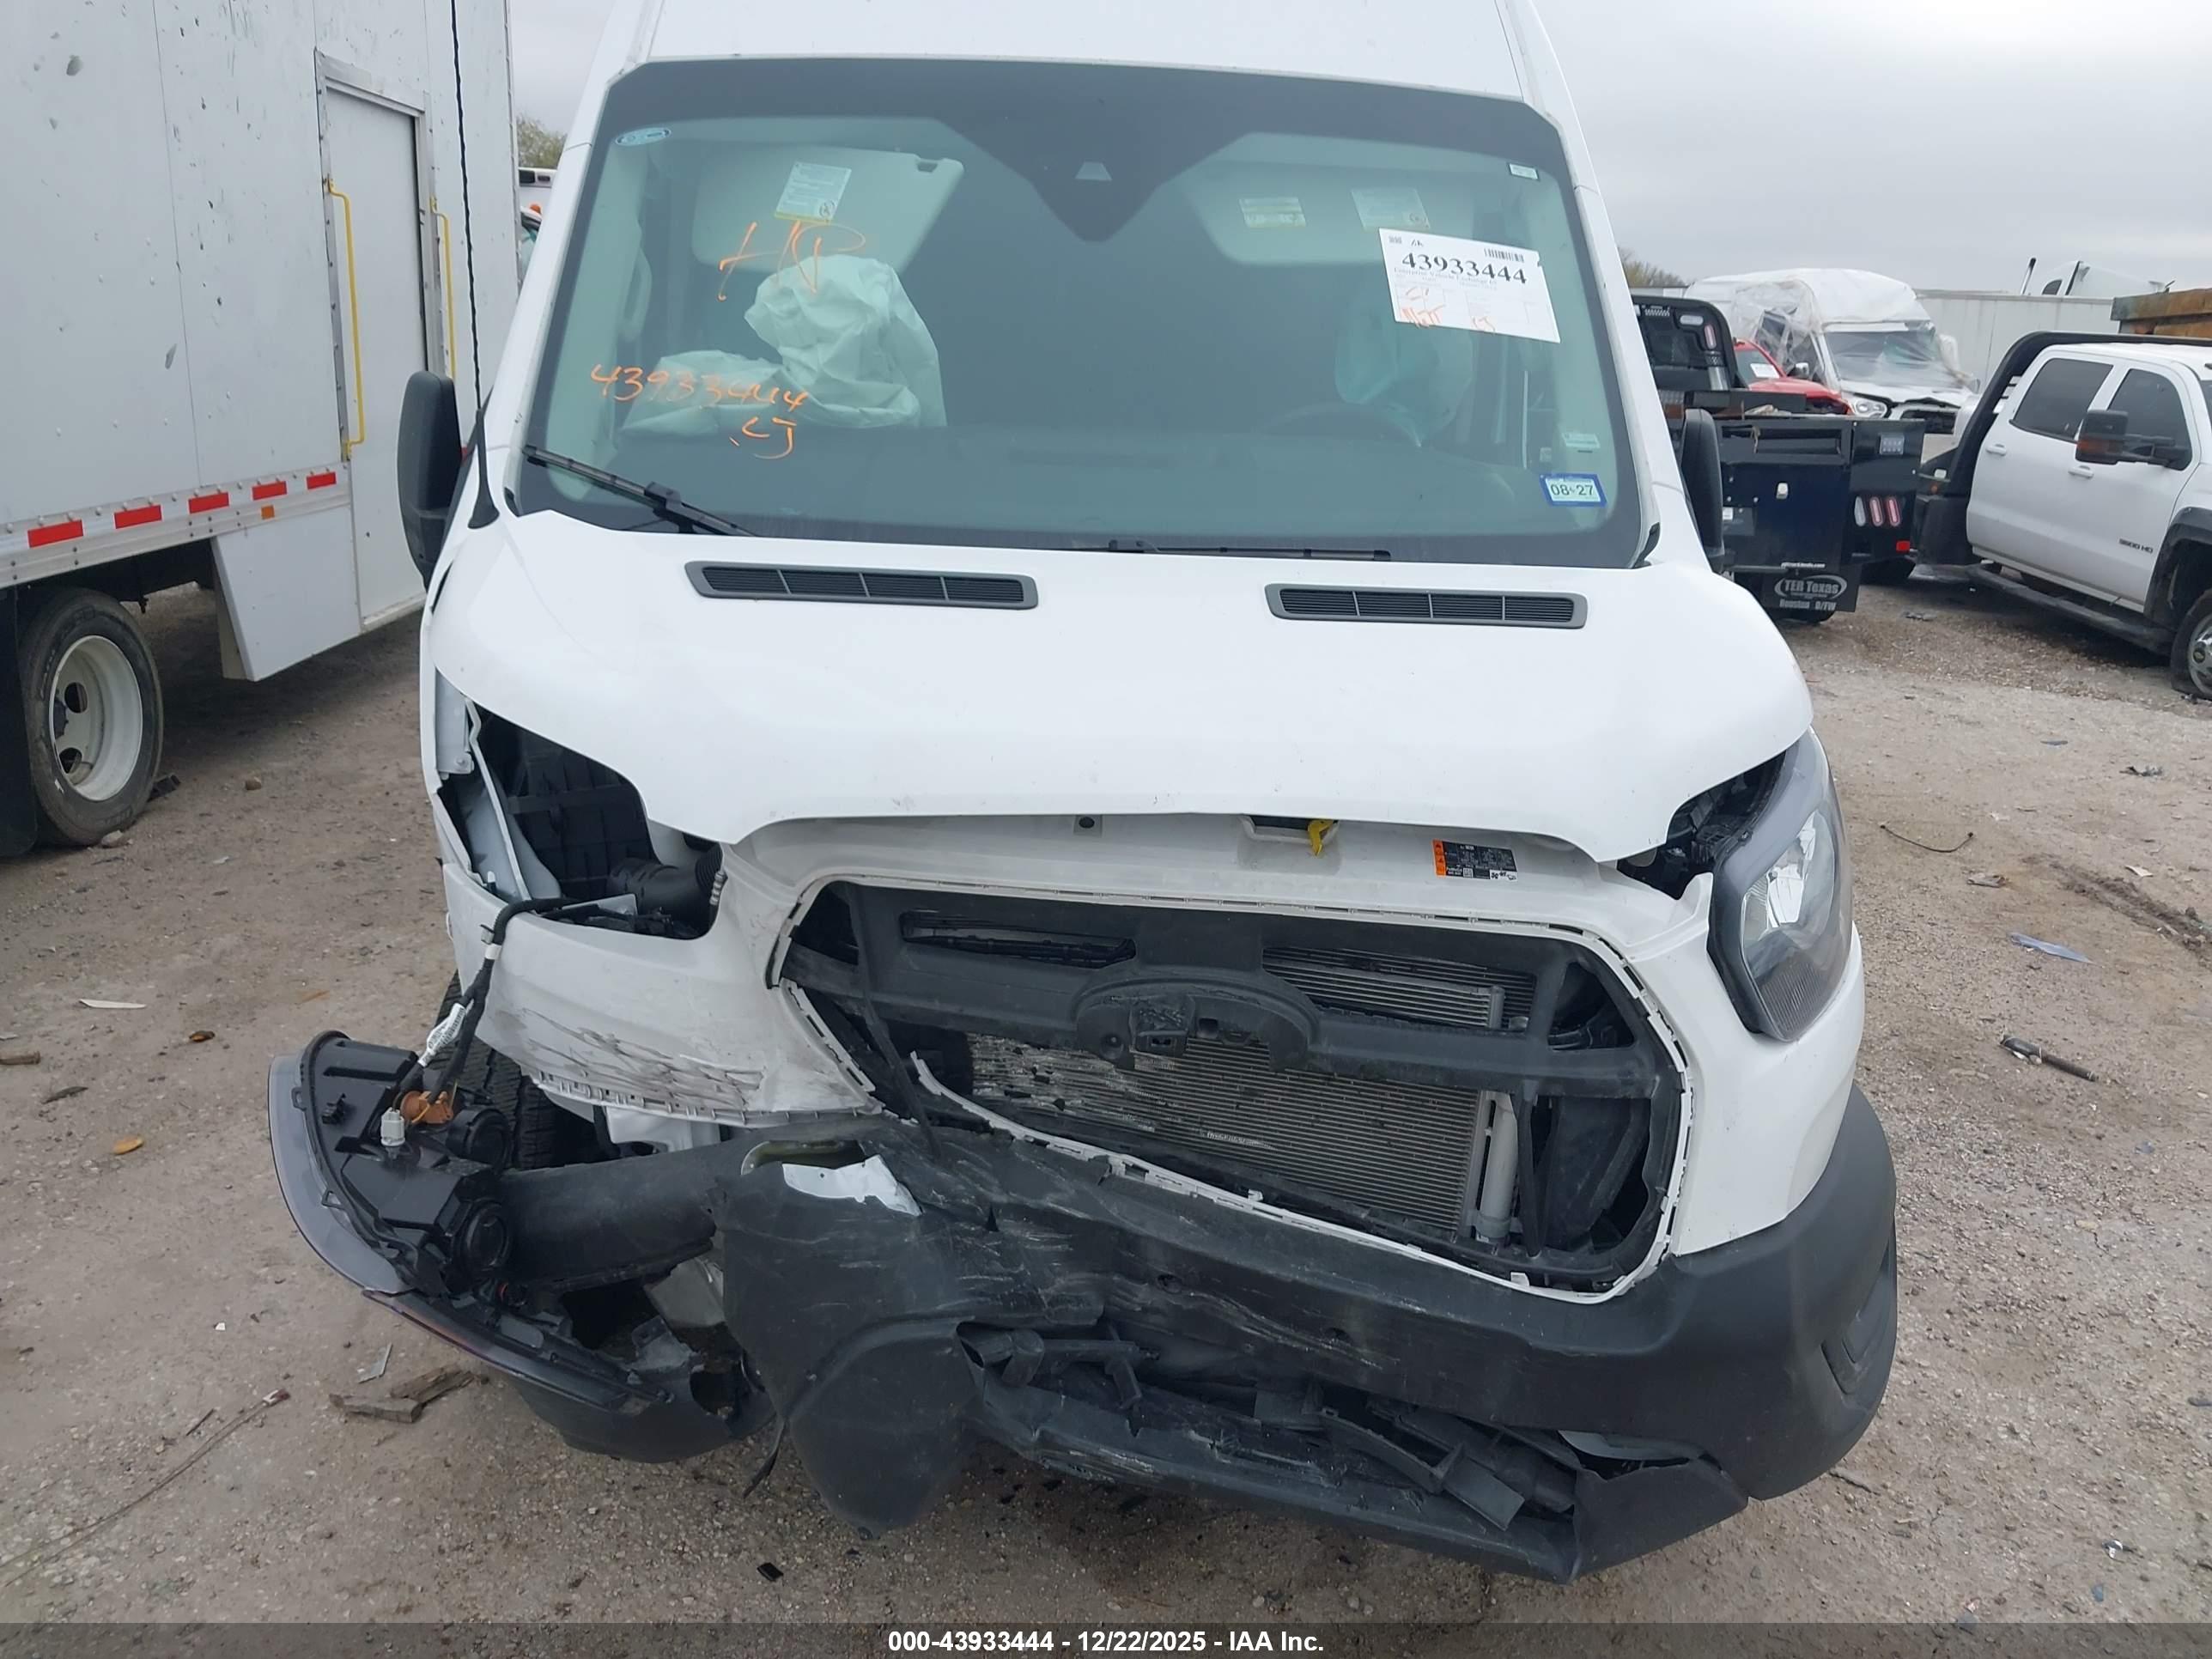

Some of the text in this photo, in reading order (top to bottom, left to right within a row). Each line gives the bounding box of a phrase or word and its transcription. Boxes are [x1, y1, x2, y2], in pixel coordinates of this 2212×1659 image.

[1401, 252, 1527, 284] 43933444
[1551, 484, 1594, 495] 08 27
[1806, 581, 1839, 594] Texas
